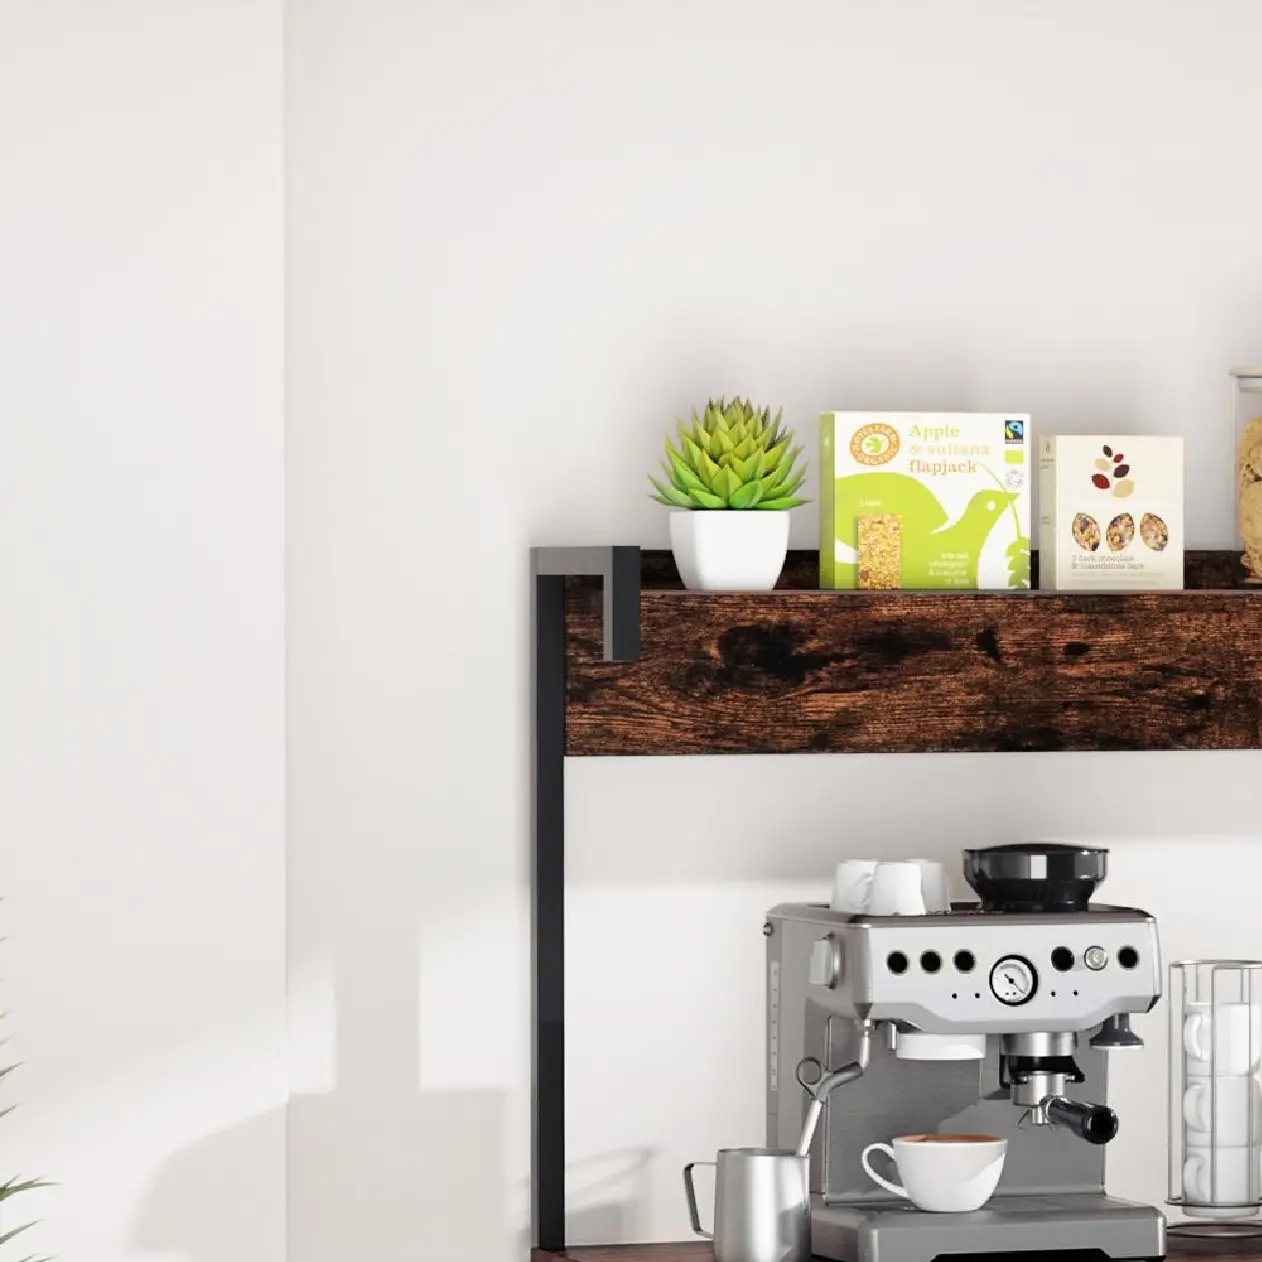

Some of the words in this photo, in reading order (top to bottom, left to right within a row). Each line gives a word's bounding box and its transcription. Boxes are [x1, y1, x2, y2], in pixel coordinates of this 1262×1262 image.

[909, 423, 960, 440] Apple
[909, 444, 922, 455] &
[926, 443, 990, 455] sultana
[908, 459, 978, 476] flapjack
